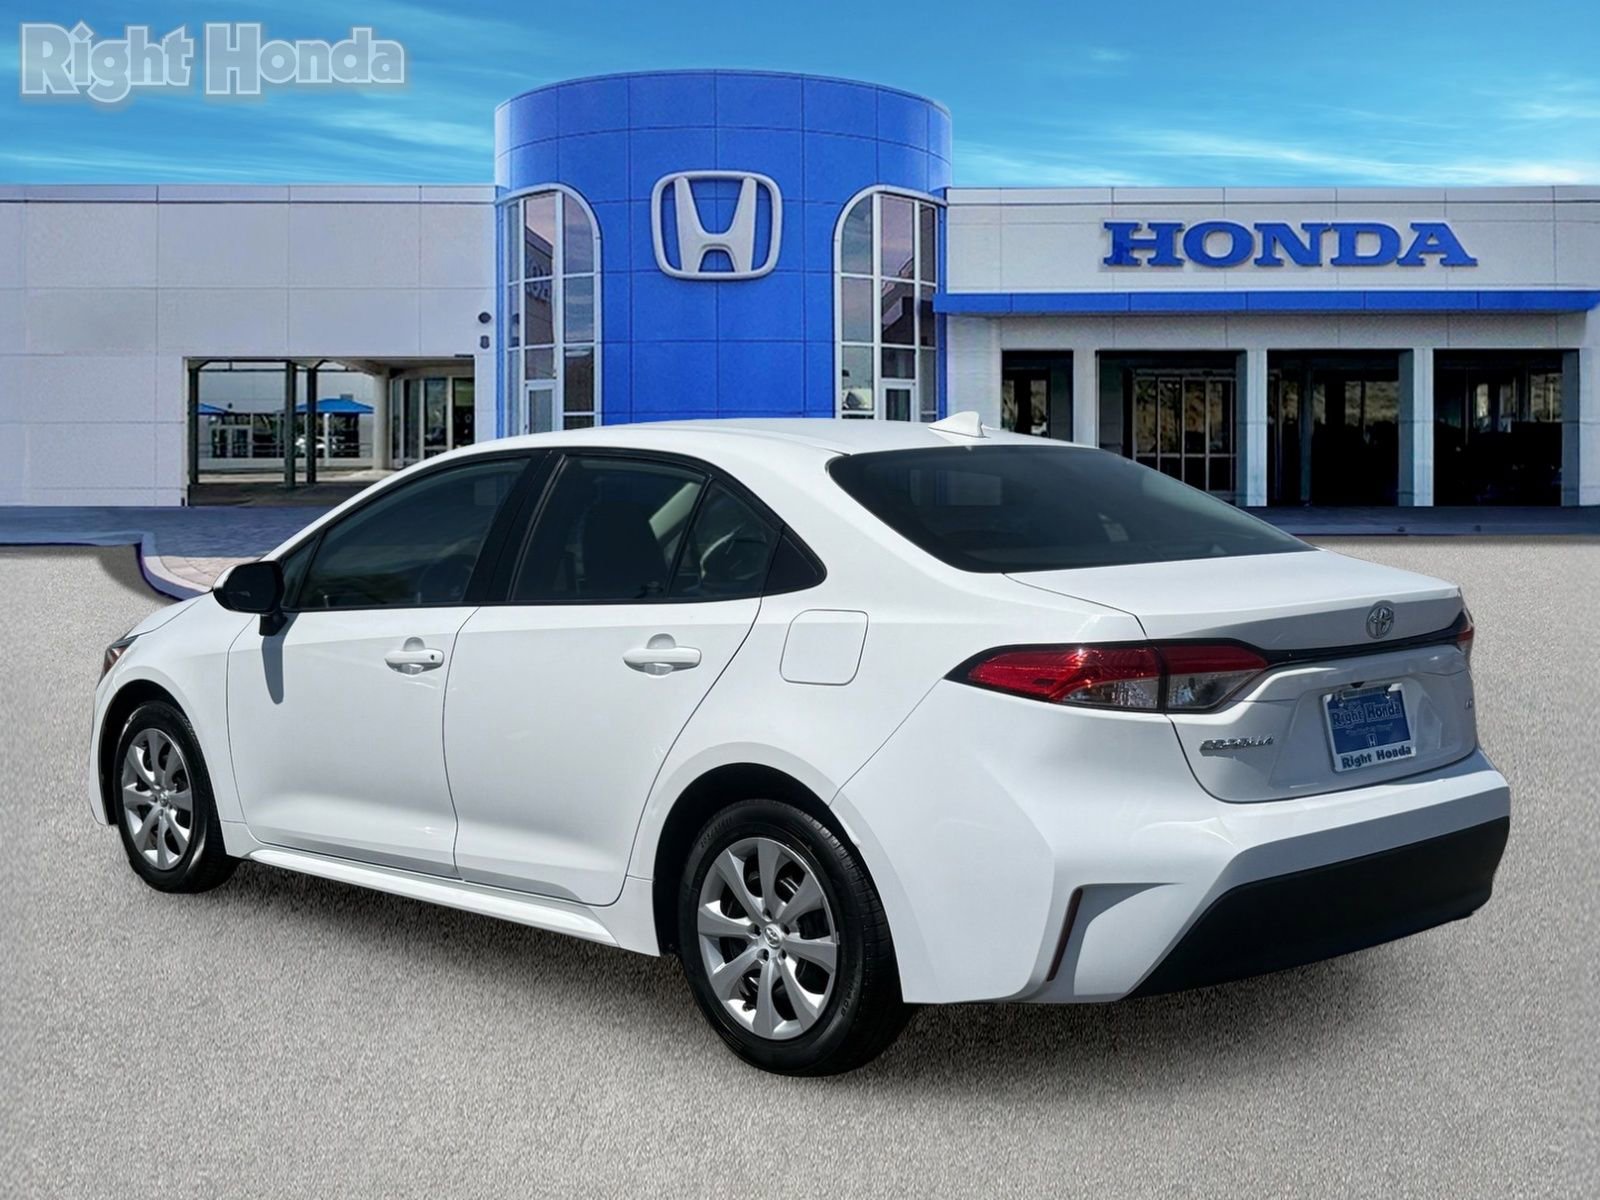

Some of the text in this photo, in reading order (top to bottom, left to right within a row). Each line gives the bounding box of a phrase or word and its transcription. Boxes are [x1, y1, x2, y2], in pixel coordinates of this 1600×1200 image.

[1103, 220, 1478, 267] HONDA
[1330, 704, 1364, 729] Right
[1365, 700, 1402, 721] Honda
[1341, 745, 1412, 769] Right Honda
